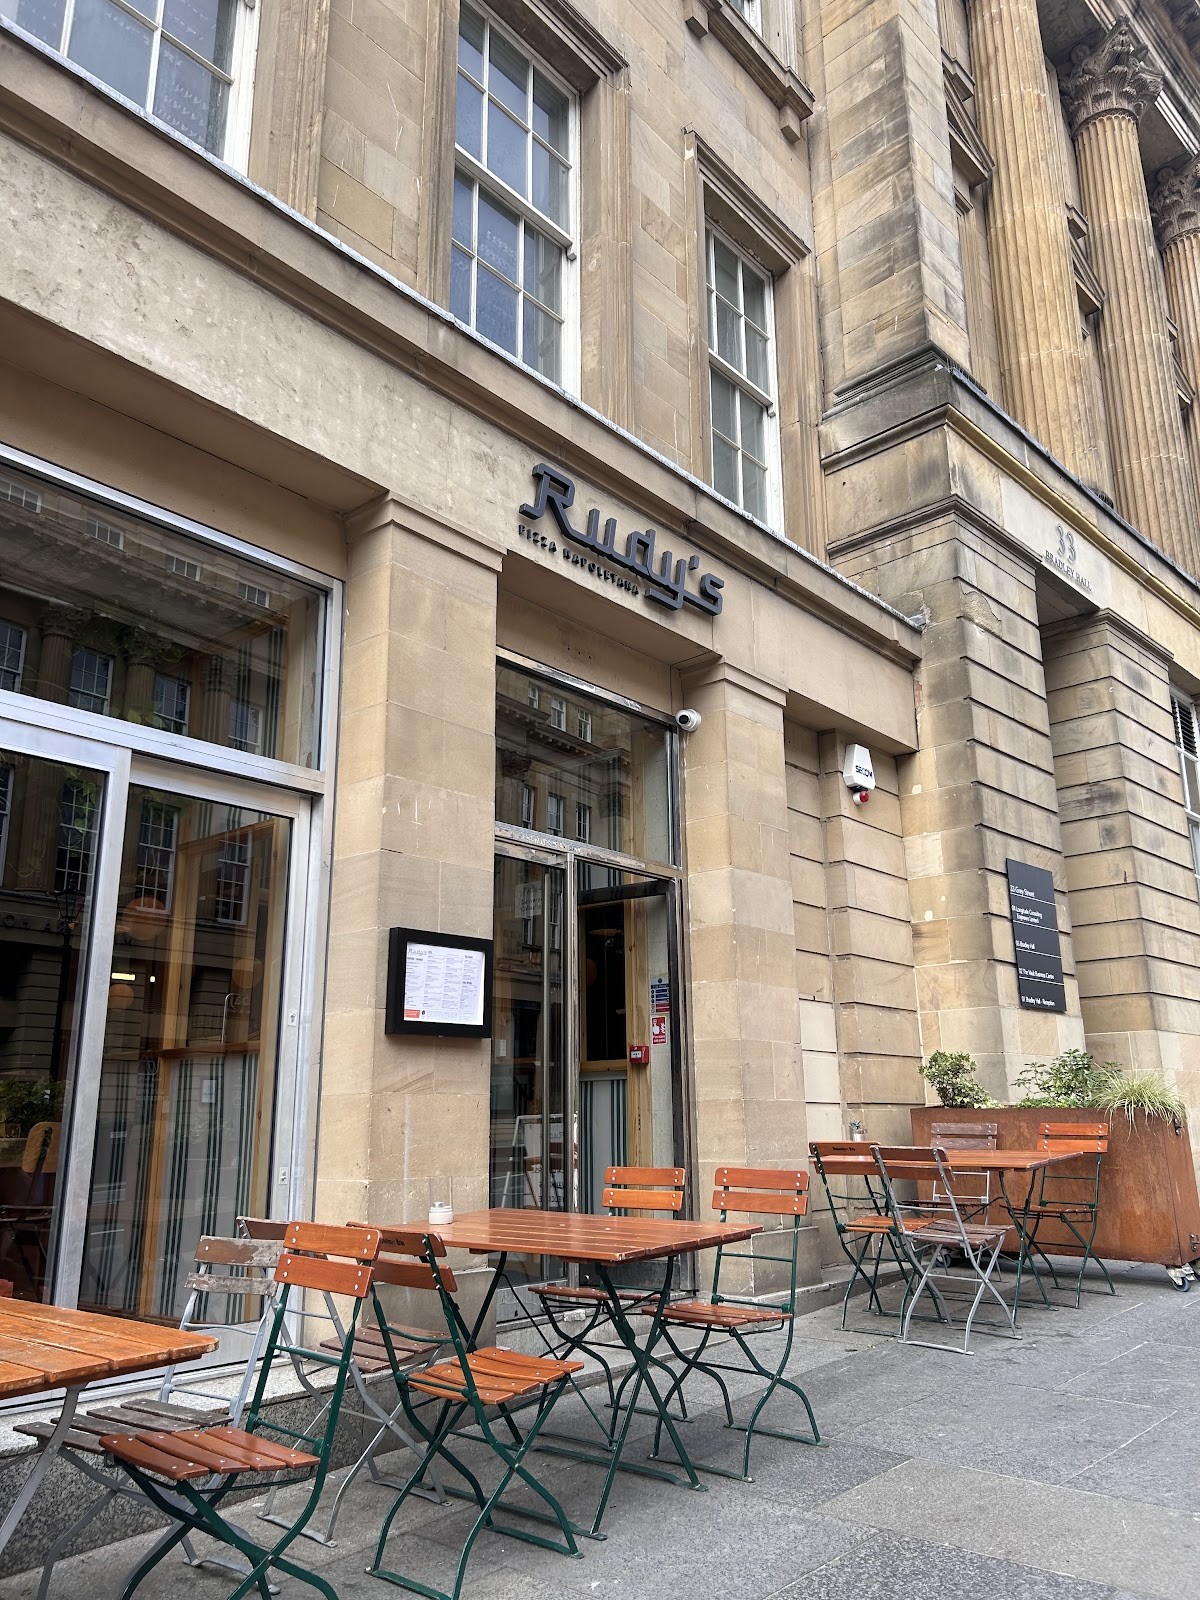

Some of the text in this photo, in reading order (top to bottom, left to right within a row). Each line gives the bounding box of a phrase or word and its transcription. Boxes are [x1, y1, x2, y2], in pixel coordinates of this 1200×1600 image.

[518, 524, 640, 596] PIZZA NAPOLETANA
[519, 462, 724, 616] Rudy's
[1057, 524, 1077, 564] 33
[1045, 549, 1092, 591] BRADLEY HALL
